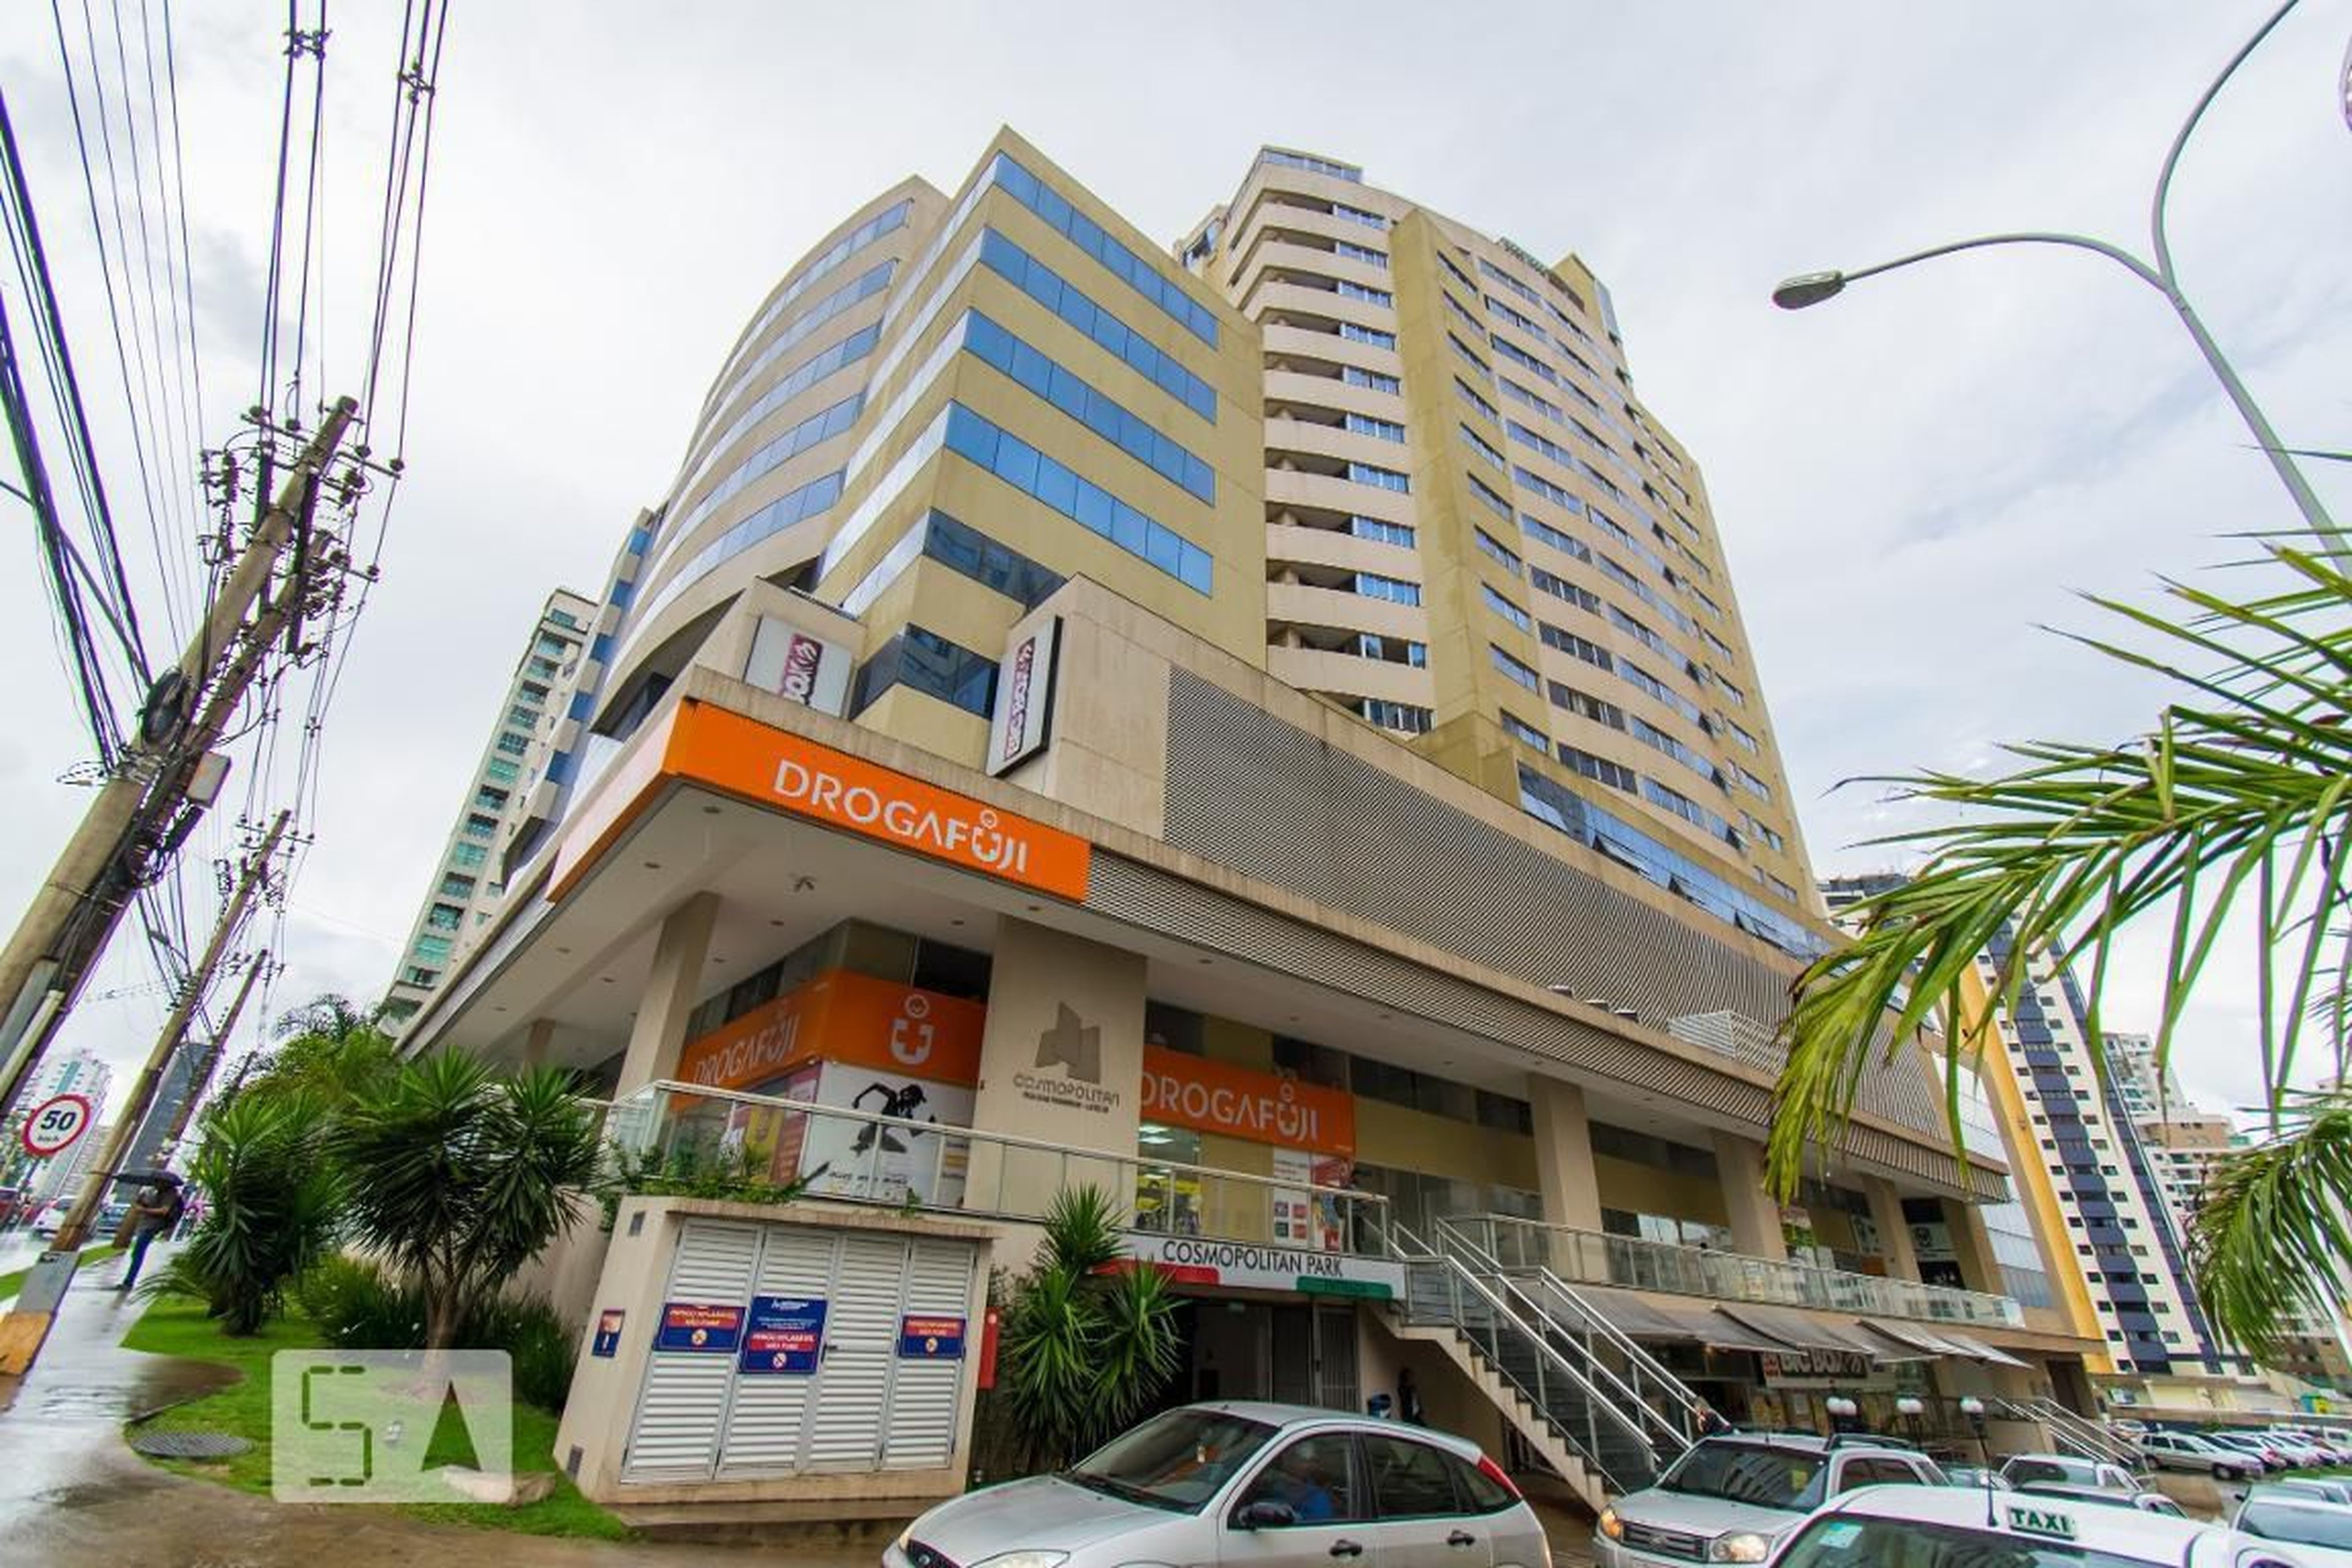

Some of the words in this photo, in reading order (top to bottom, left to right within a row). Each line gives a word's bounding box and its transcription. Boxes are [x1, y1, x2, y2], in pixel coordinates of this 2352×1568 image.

[774, 760, 1027, 872] DROGAFUJI
[40, 1110, 77, 1131] 50
[1164, 1240, 1302, 1273] COSMOPOLITAN
[1306, 1256, 1343, 1277] PARK
[2010, 1507, 2068, 1532] TAXI
